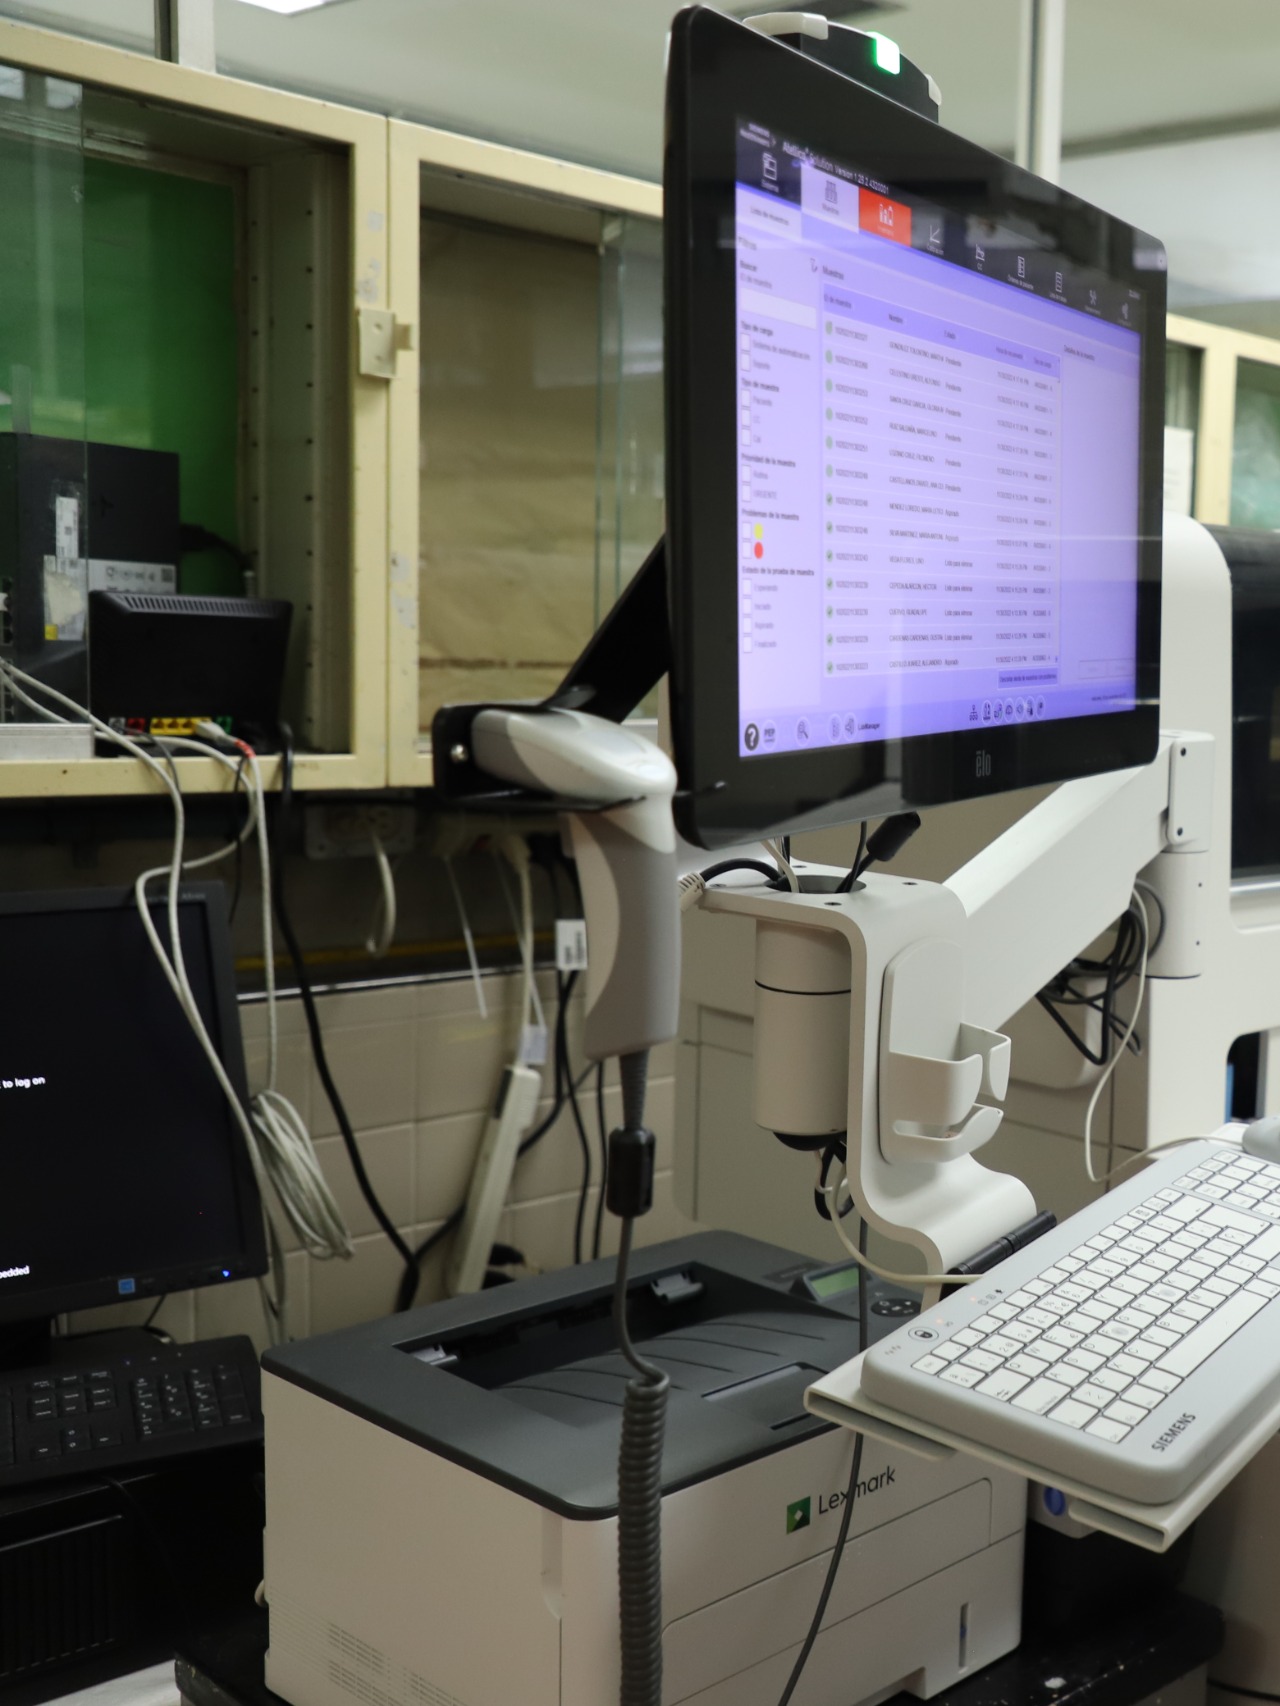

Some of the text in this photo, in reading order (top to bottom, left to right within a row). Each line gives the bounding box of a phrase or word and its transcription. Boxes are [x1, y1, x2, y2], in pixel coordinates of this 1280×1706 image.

[2, 1077, 46, 1089] to log on
[1151, 1412, 1196, 1452] SIEMENS
[818, 1465, 897, 1516] Lexmark
